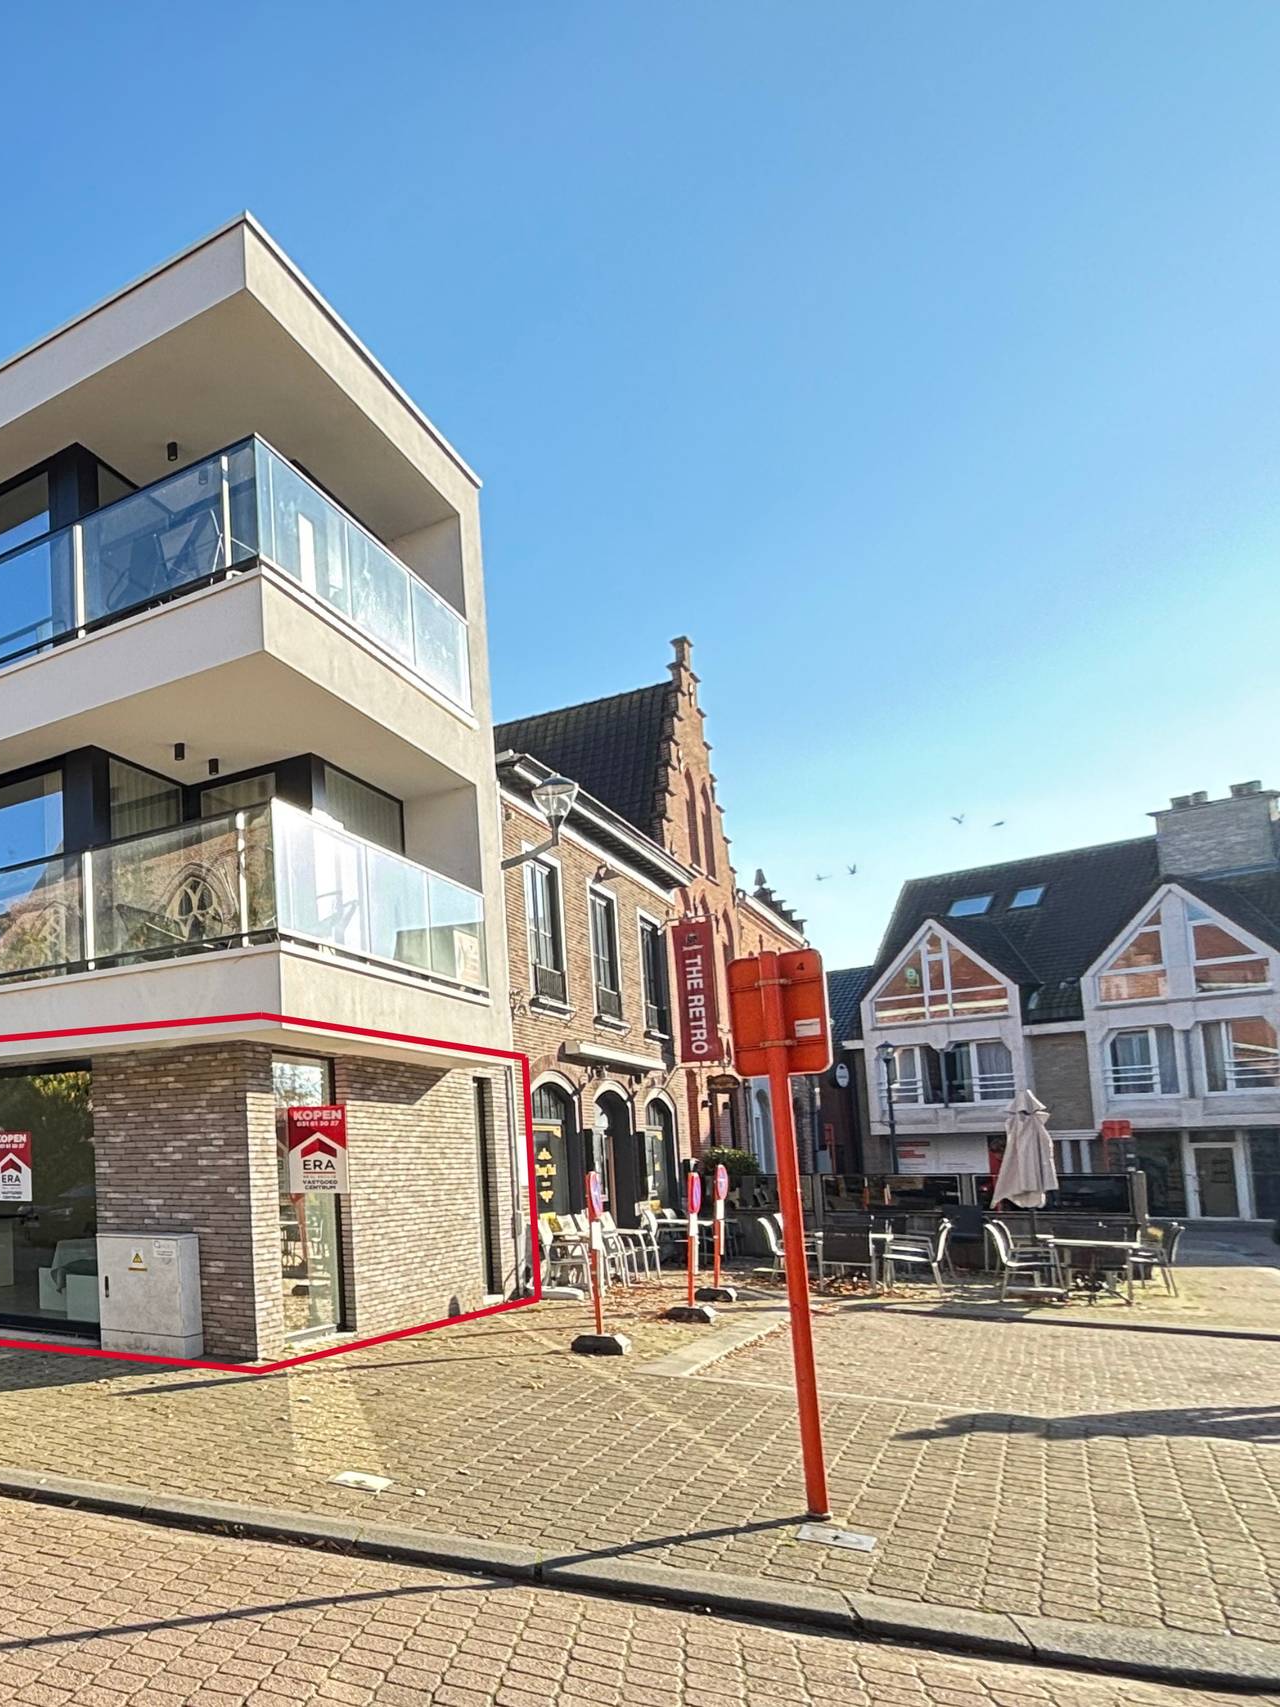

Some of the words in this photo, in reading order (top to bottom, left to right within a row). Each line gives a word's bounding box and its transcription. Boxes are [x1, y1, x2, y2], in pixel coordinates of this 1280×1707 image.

[796, 962, 805, 971] 4
[685, 955, 704, 990] THE
[688, 994, 709, 1055] RETRO
[293, 1110, 342, 1121] KOPEN
[303, 1159, 336, 1171] ERA
[1, 1174, 22, 1183] ERA
